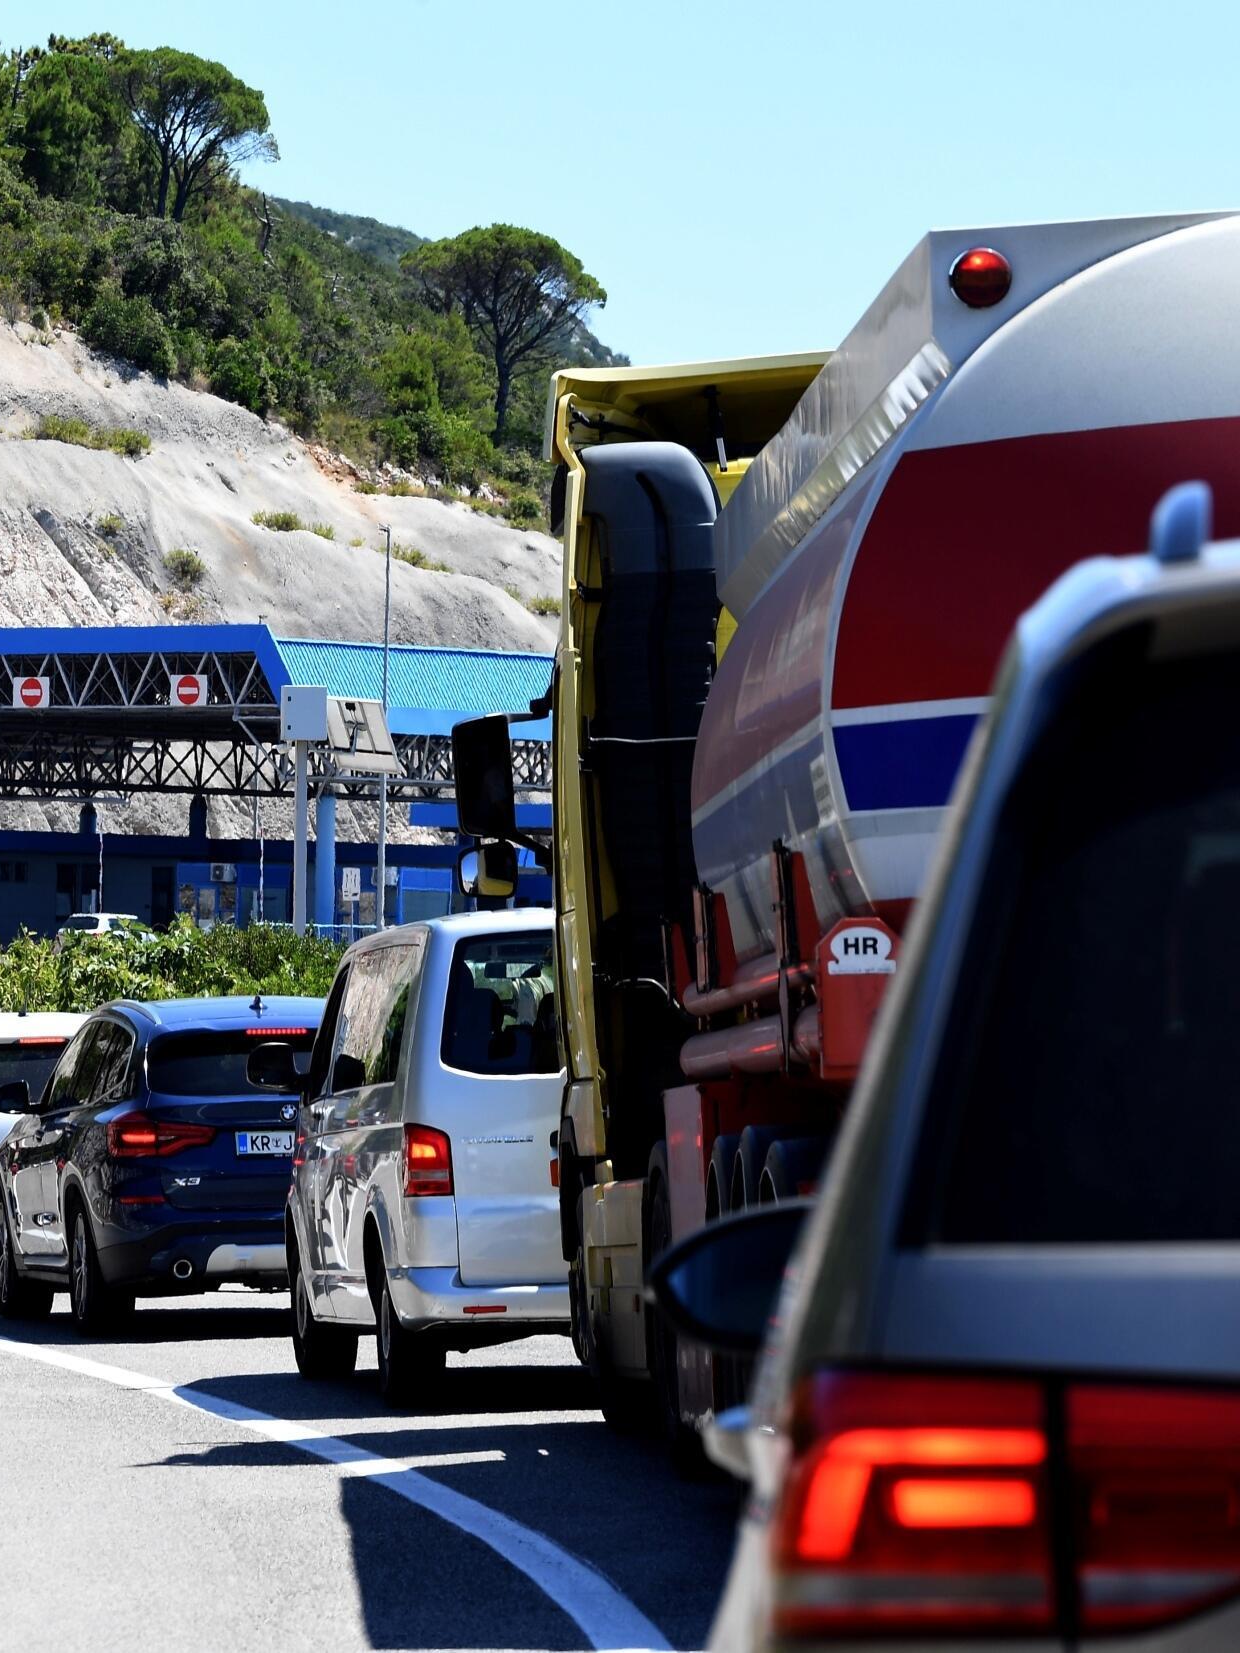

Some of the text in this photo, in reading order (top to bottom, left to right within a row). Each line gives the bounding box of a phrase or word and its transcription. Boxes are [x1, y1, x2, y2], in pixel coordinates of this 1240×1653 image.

[843, 936, 879, 956] HR
[250, 1135, 271, 1152] KR
[172, 1177, 201, 1187] X3
